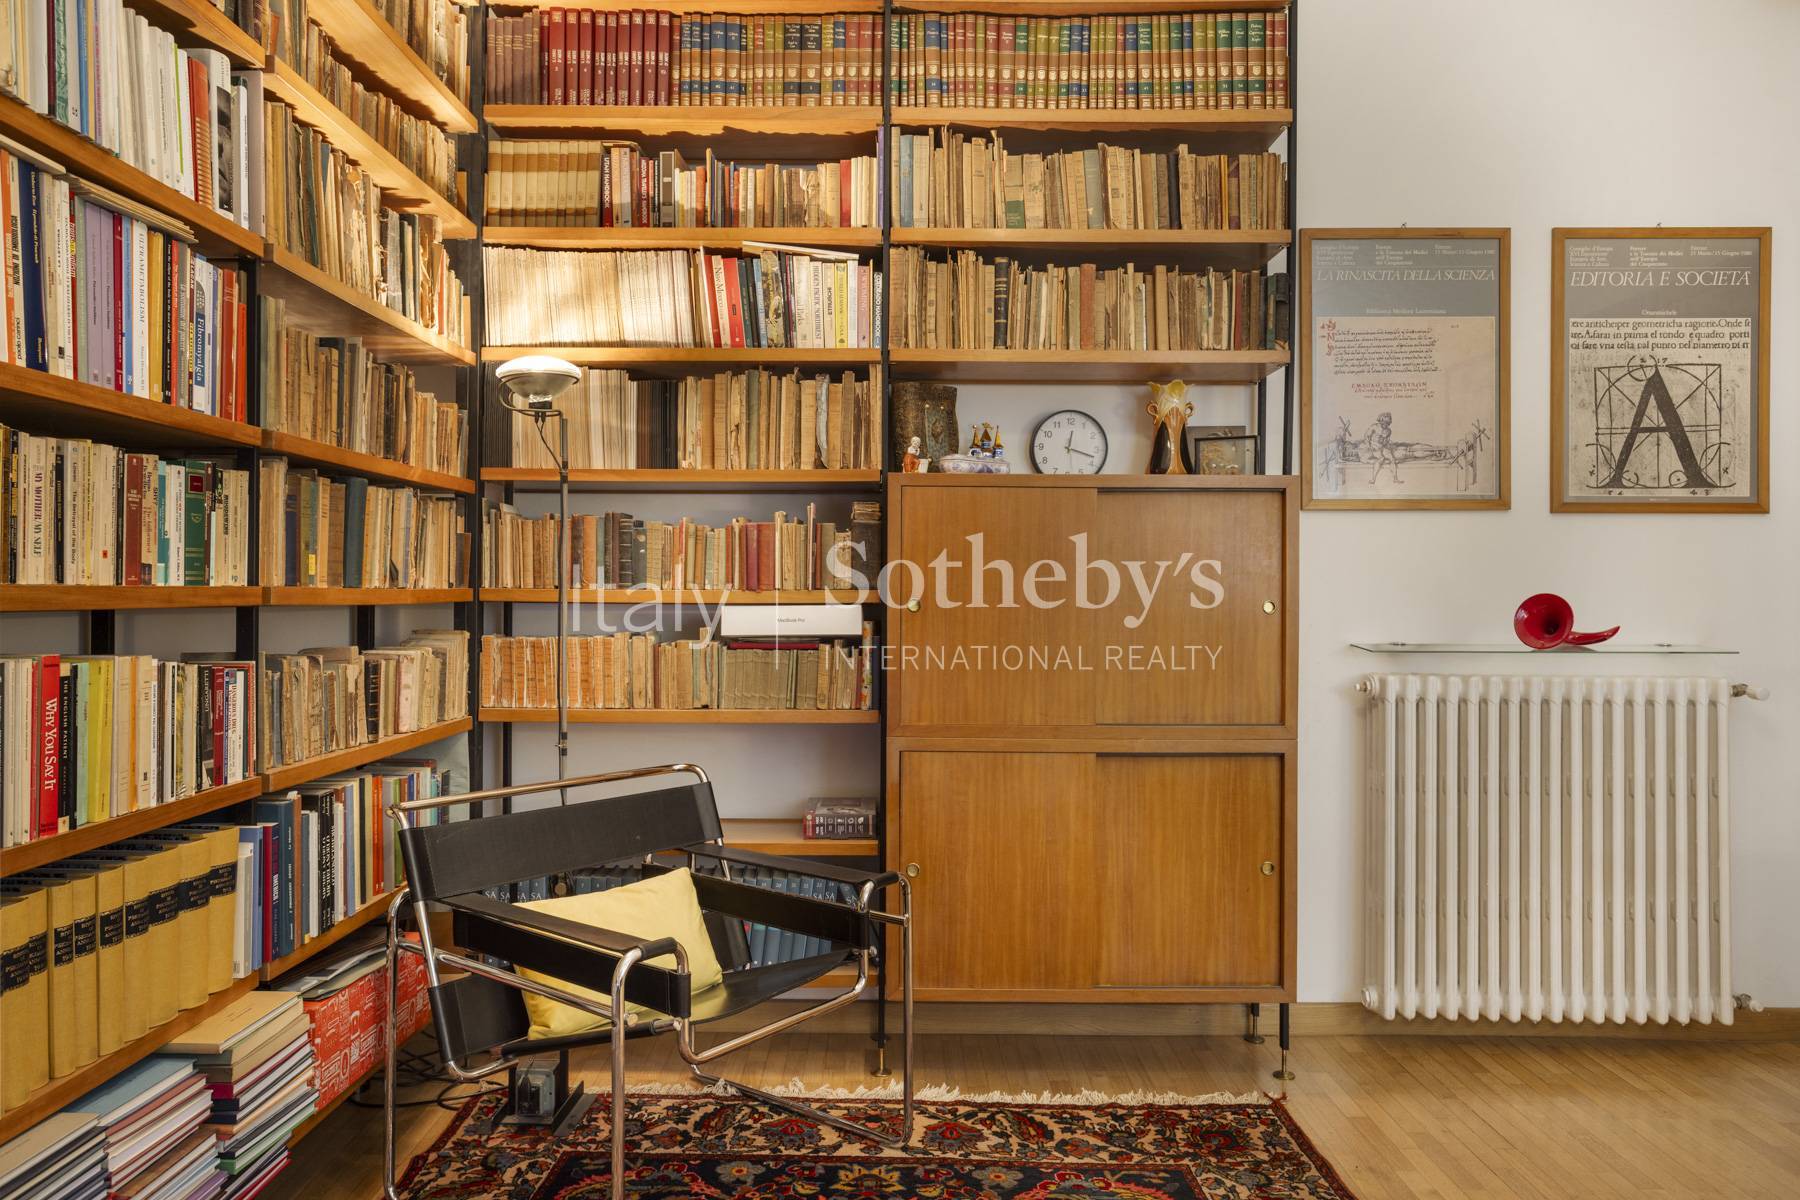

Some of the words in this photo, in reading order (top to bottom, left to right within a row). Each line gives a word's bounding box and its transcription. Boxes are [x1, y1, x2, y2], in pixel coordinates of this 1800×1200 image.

[1316, 270, 1335, 281] LA
[1336, 270, 1400, 281] RINASCITA
[1403, 270, 1443, 281] DELLA
[1443, 270, 1496, 281] SCIENZA
[1570, 270, 1654, 287] EDITORIA
[1660, 271, 1671, 286] E
[195, 318, 205, 381] Fibromyalgia
[1603, 366, 1718, 488] A
[34, 472, 43, 482] MY
[33, 536, 42, 557] SELF
